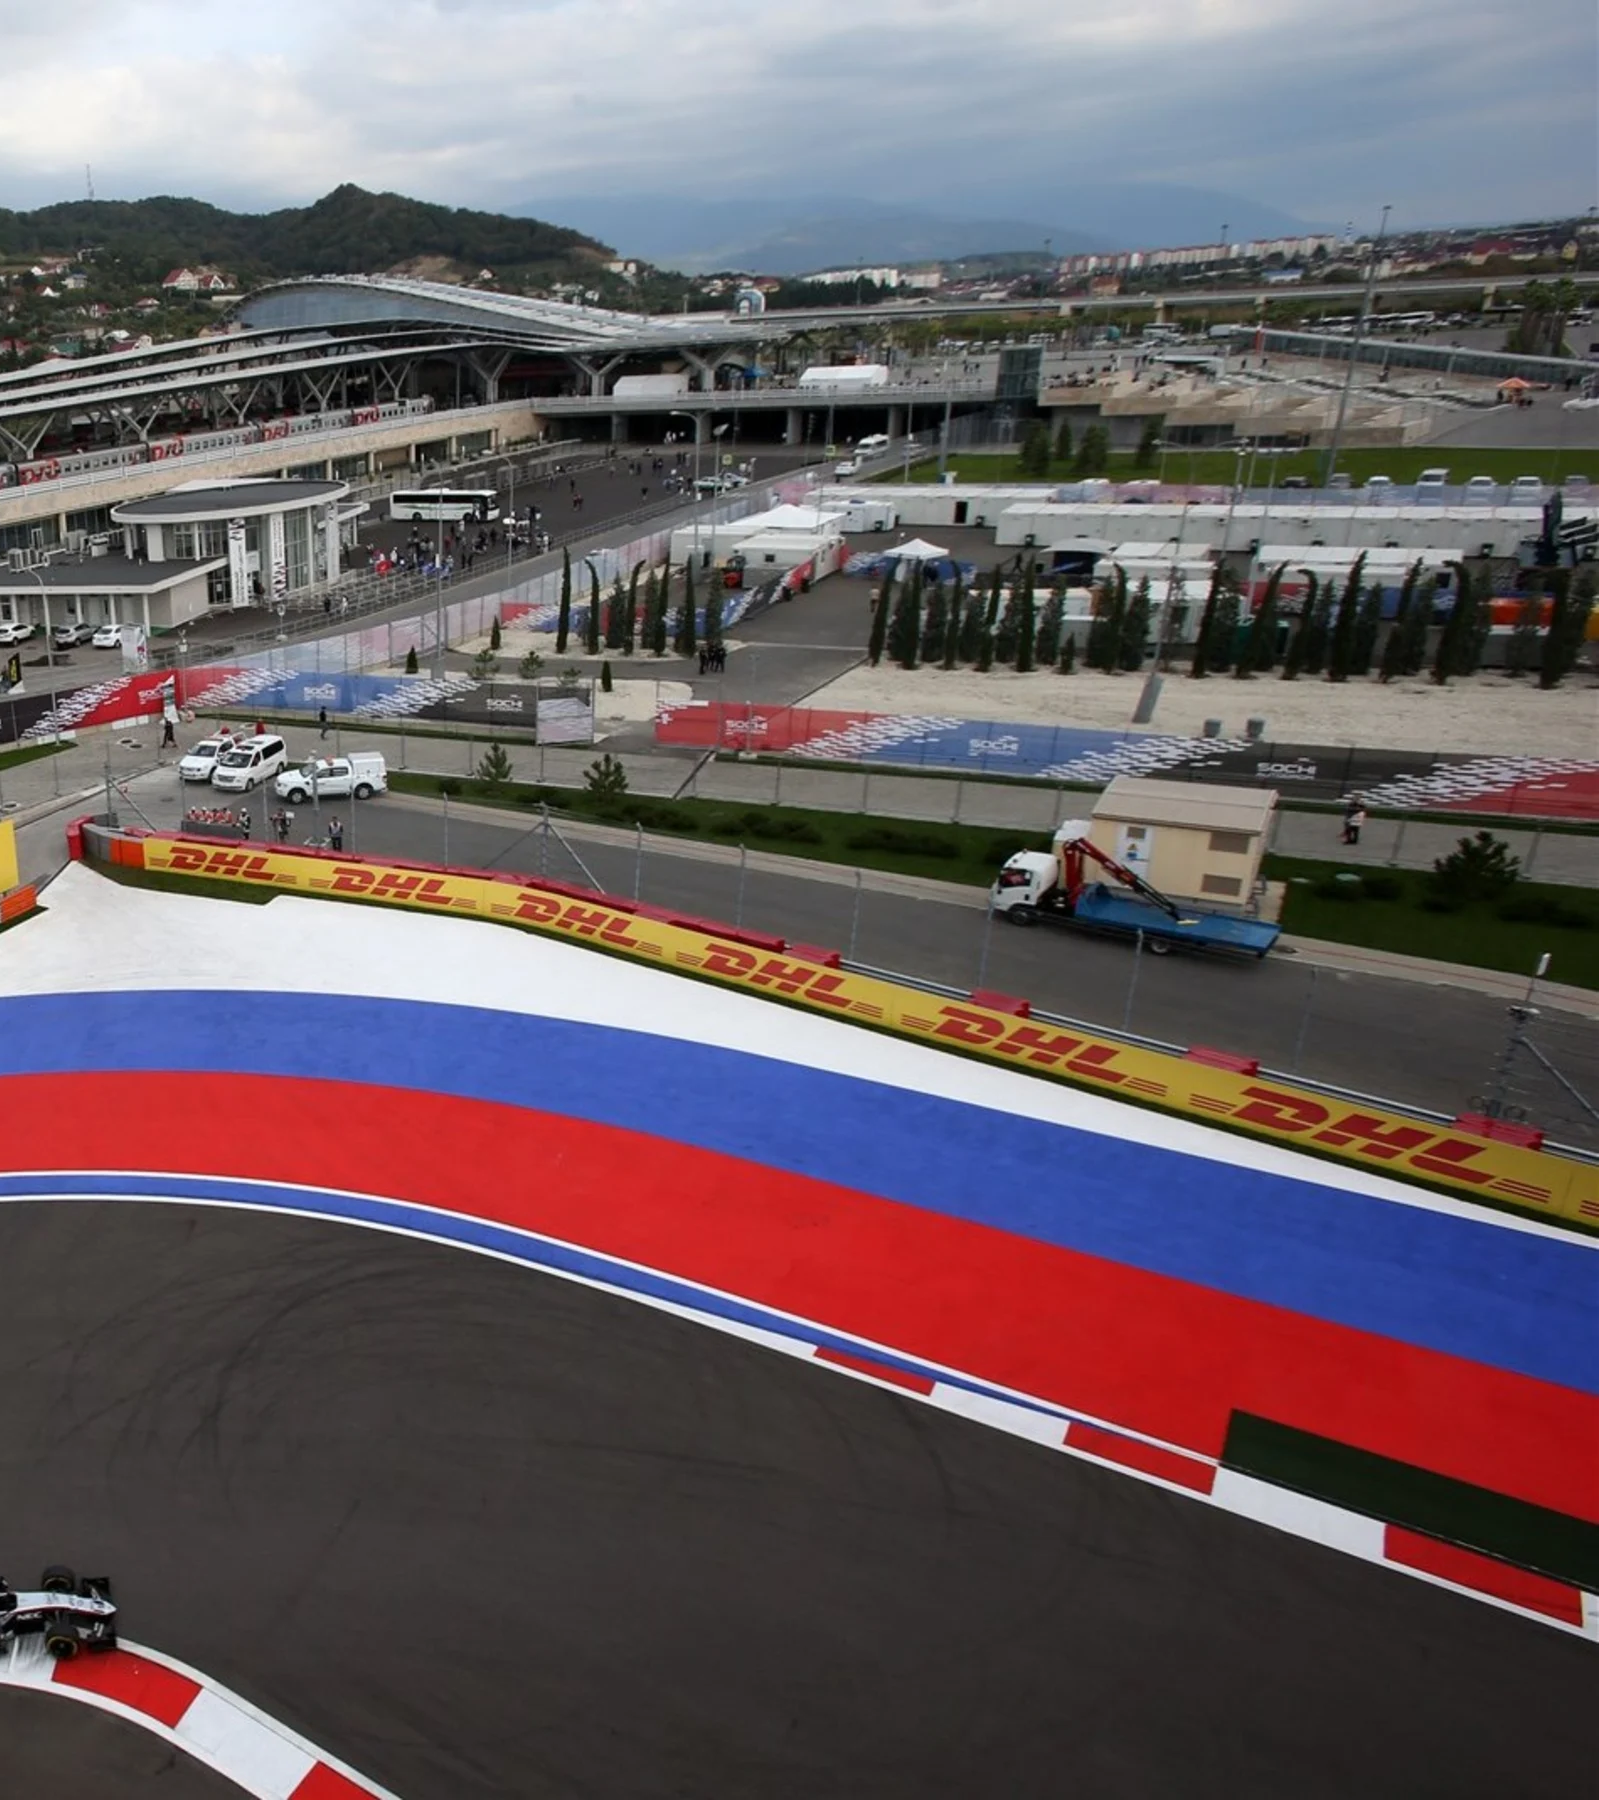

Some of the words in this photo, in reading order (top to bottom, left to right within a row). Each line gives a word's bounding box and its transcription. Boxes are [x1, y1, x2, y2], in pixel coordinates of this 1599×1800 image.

[1257, 762, 1316, 775] SOCHI
[168, 847, 276, 881] DHL
[330, 867, 457, 906] DHL
[516, 893, 639, 948] DHL
[701, 943, 852, 1008] DHL
[933, 1006, 1128, 1083] DHL
[1231, 1087, 1495, 1184] DHL
